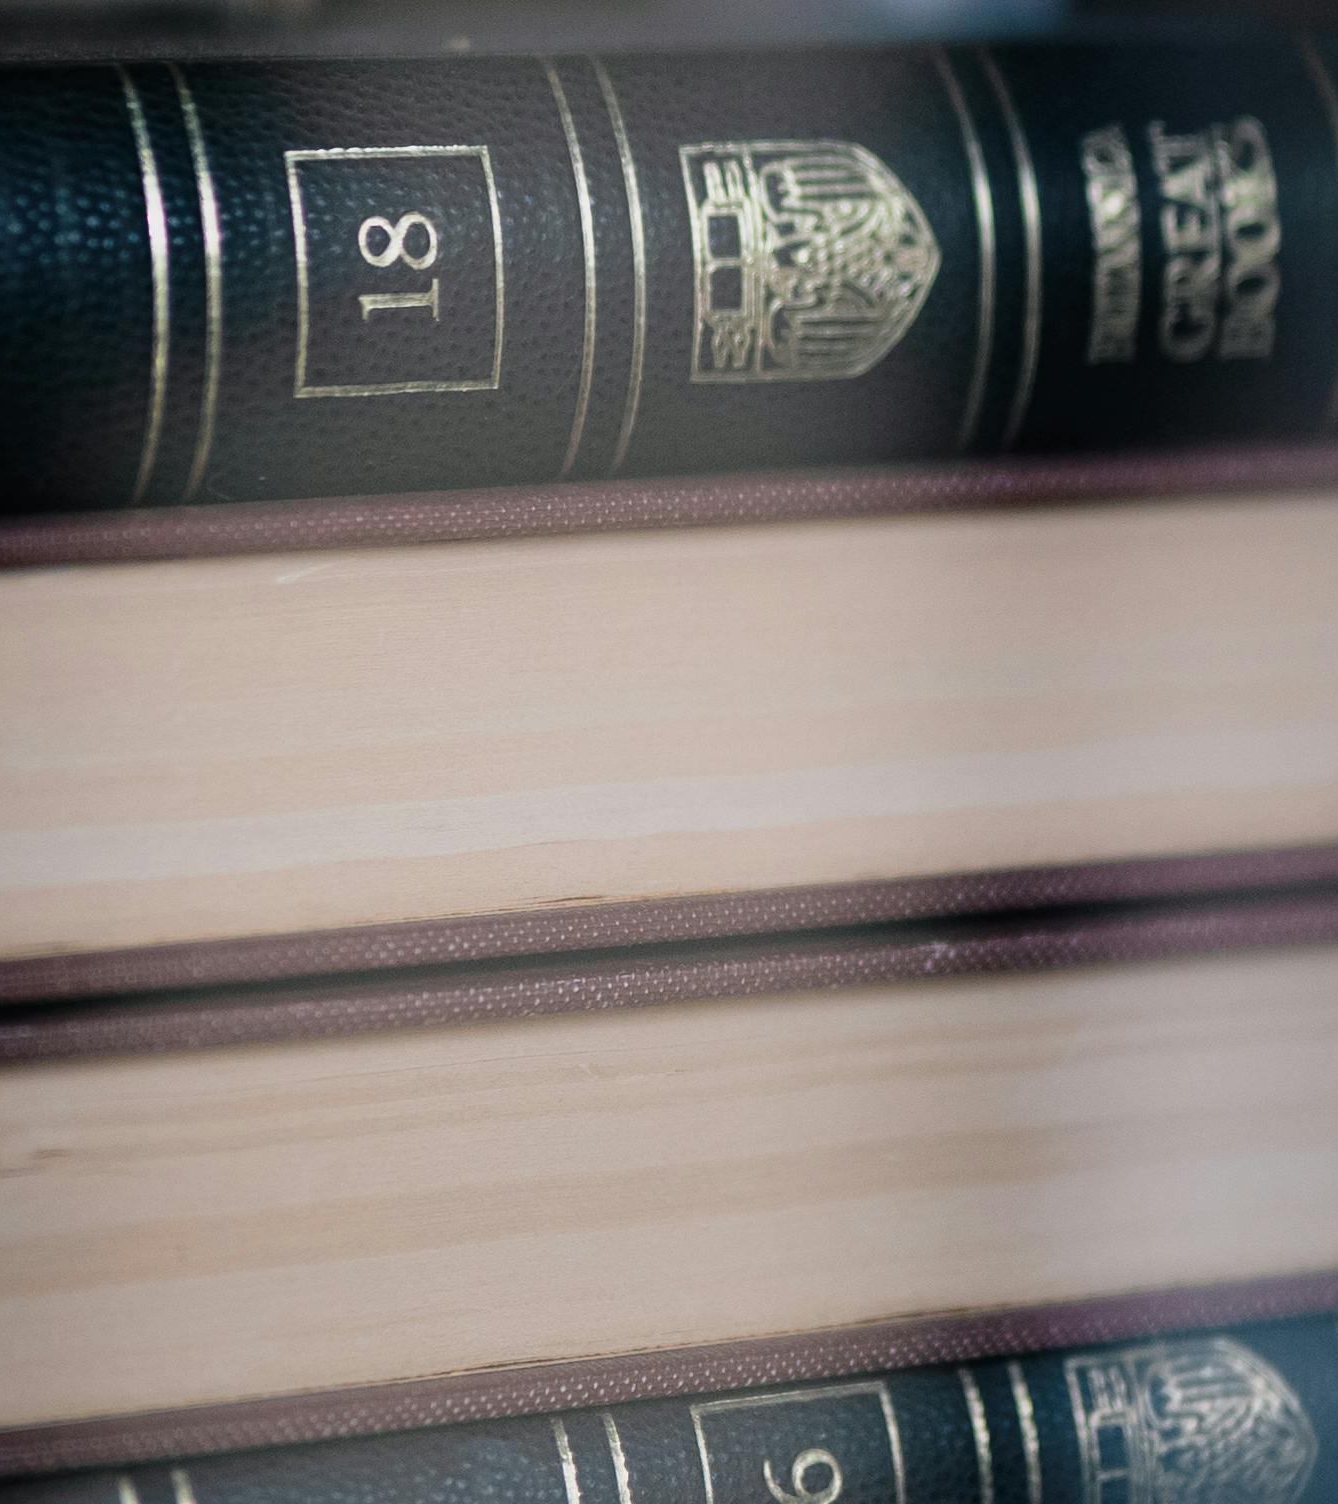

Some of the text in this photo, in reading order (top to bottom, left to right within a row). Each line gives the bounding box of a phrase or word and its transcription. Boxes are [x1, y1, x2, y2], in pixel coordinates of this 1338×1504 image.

[358, 211, 441, 322] 18
[1147, 119, 1223, 365] GREAT
[1209, 114, 1281, 360] BOOKS
